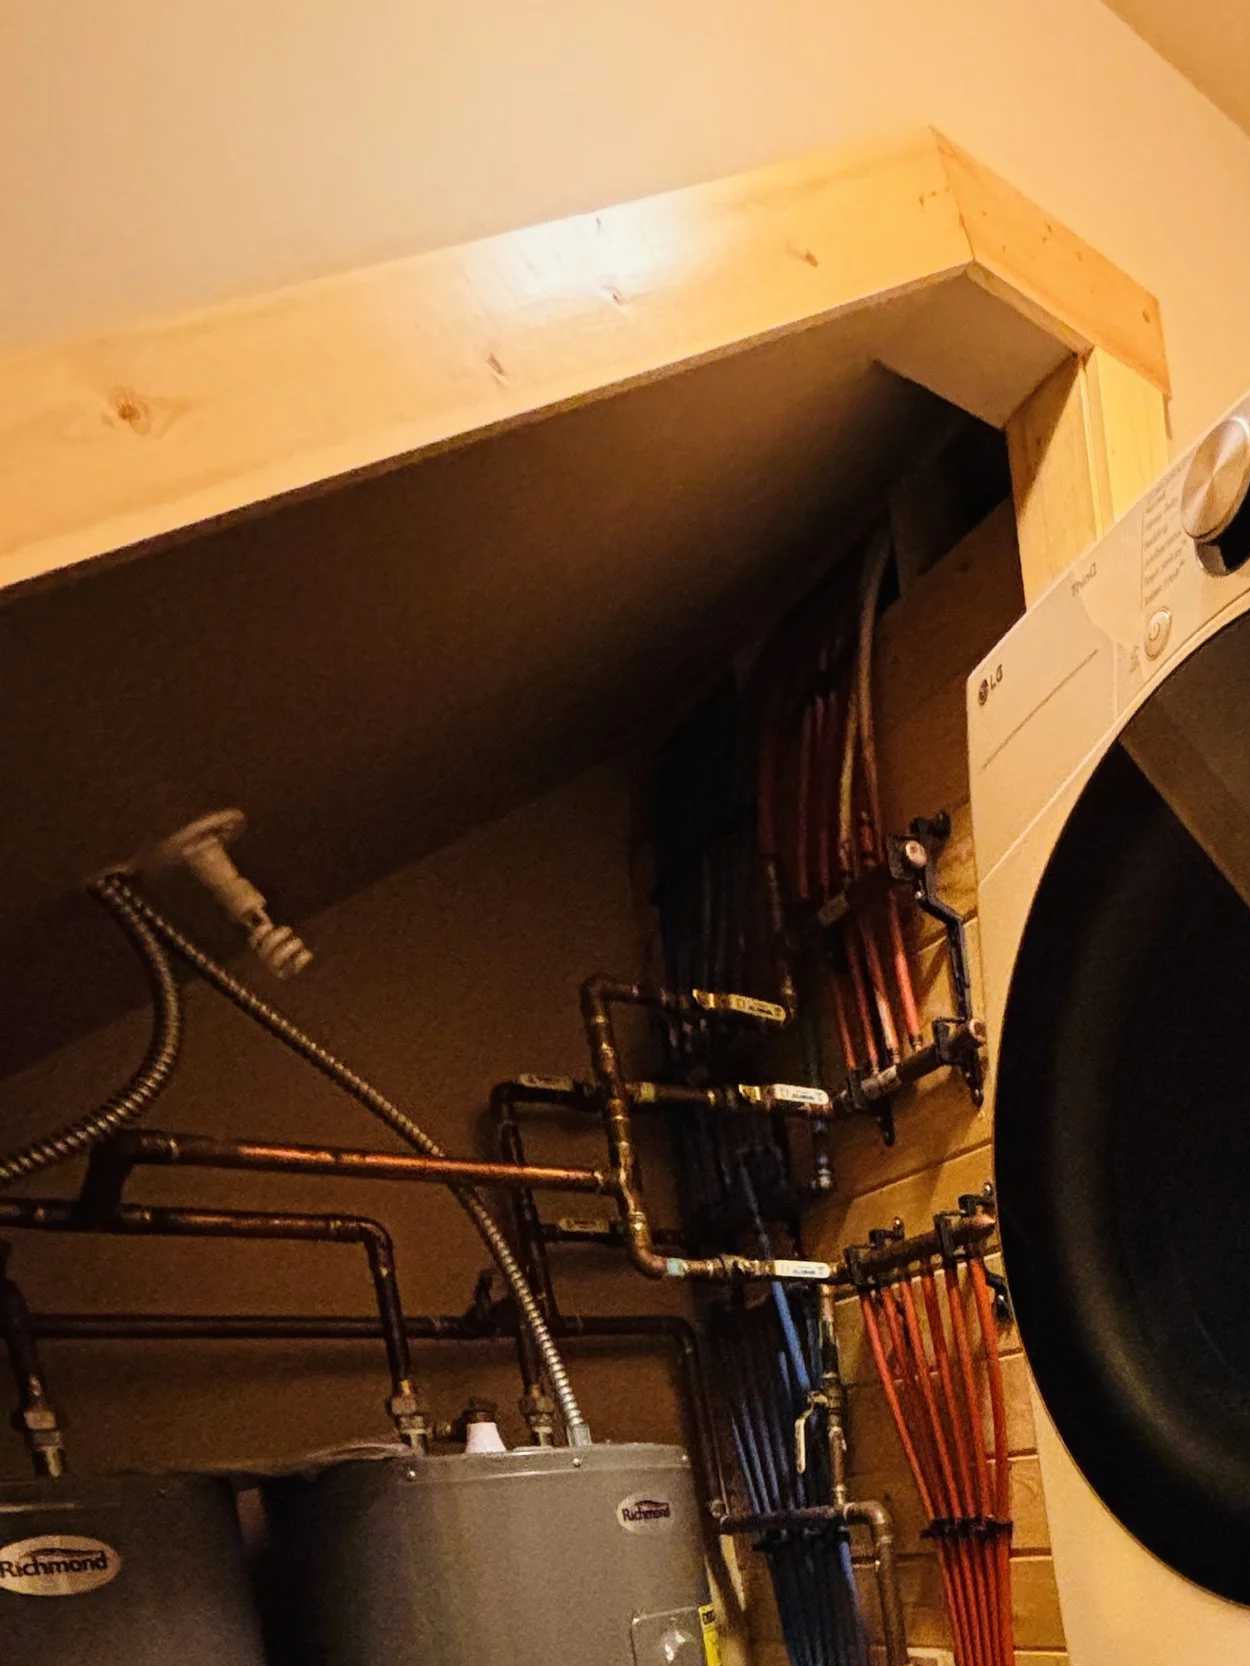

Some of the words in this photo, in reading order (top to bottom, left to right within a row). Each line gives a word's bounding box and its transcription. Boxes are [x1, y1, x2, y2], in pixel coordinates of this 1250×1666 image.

[990, 663, 1003, 690] LG
[622, 1504, 671, 1522] Richmond
[0, 1551, 108, 1579] Richmond
